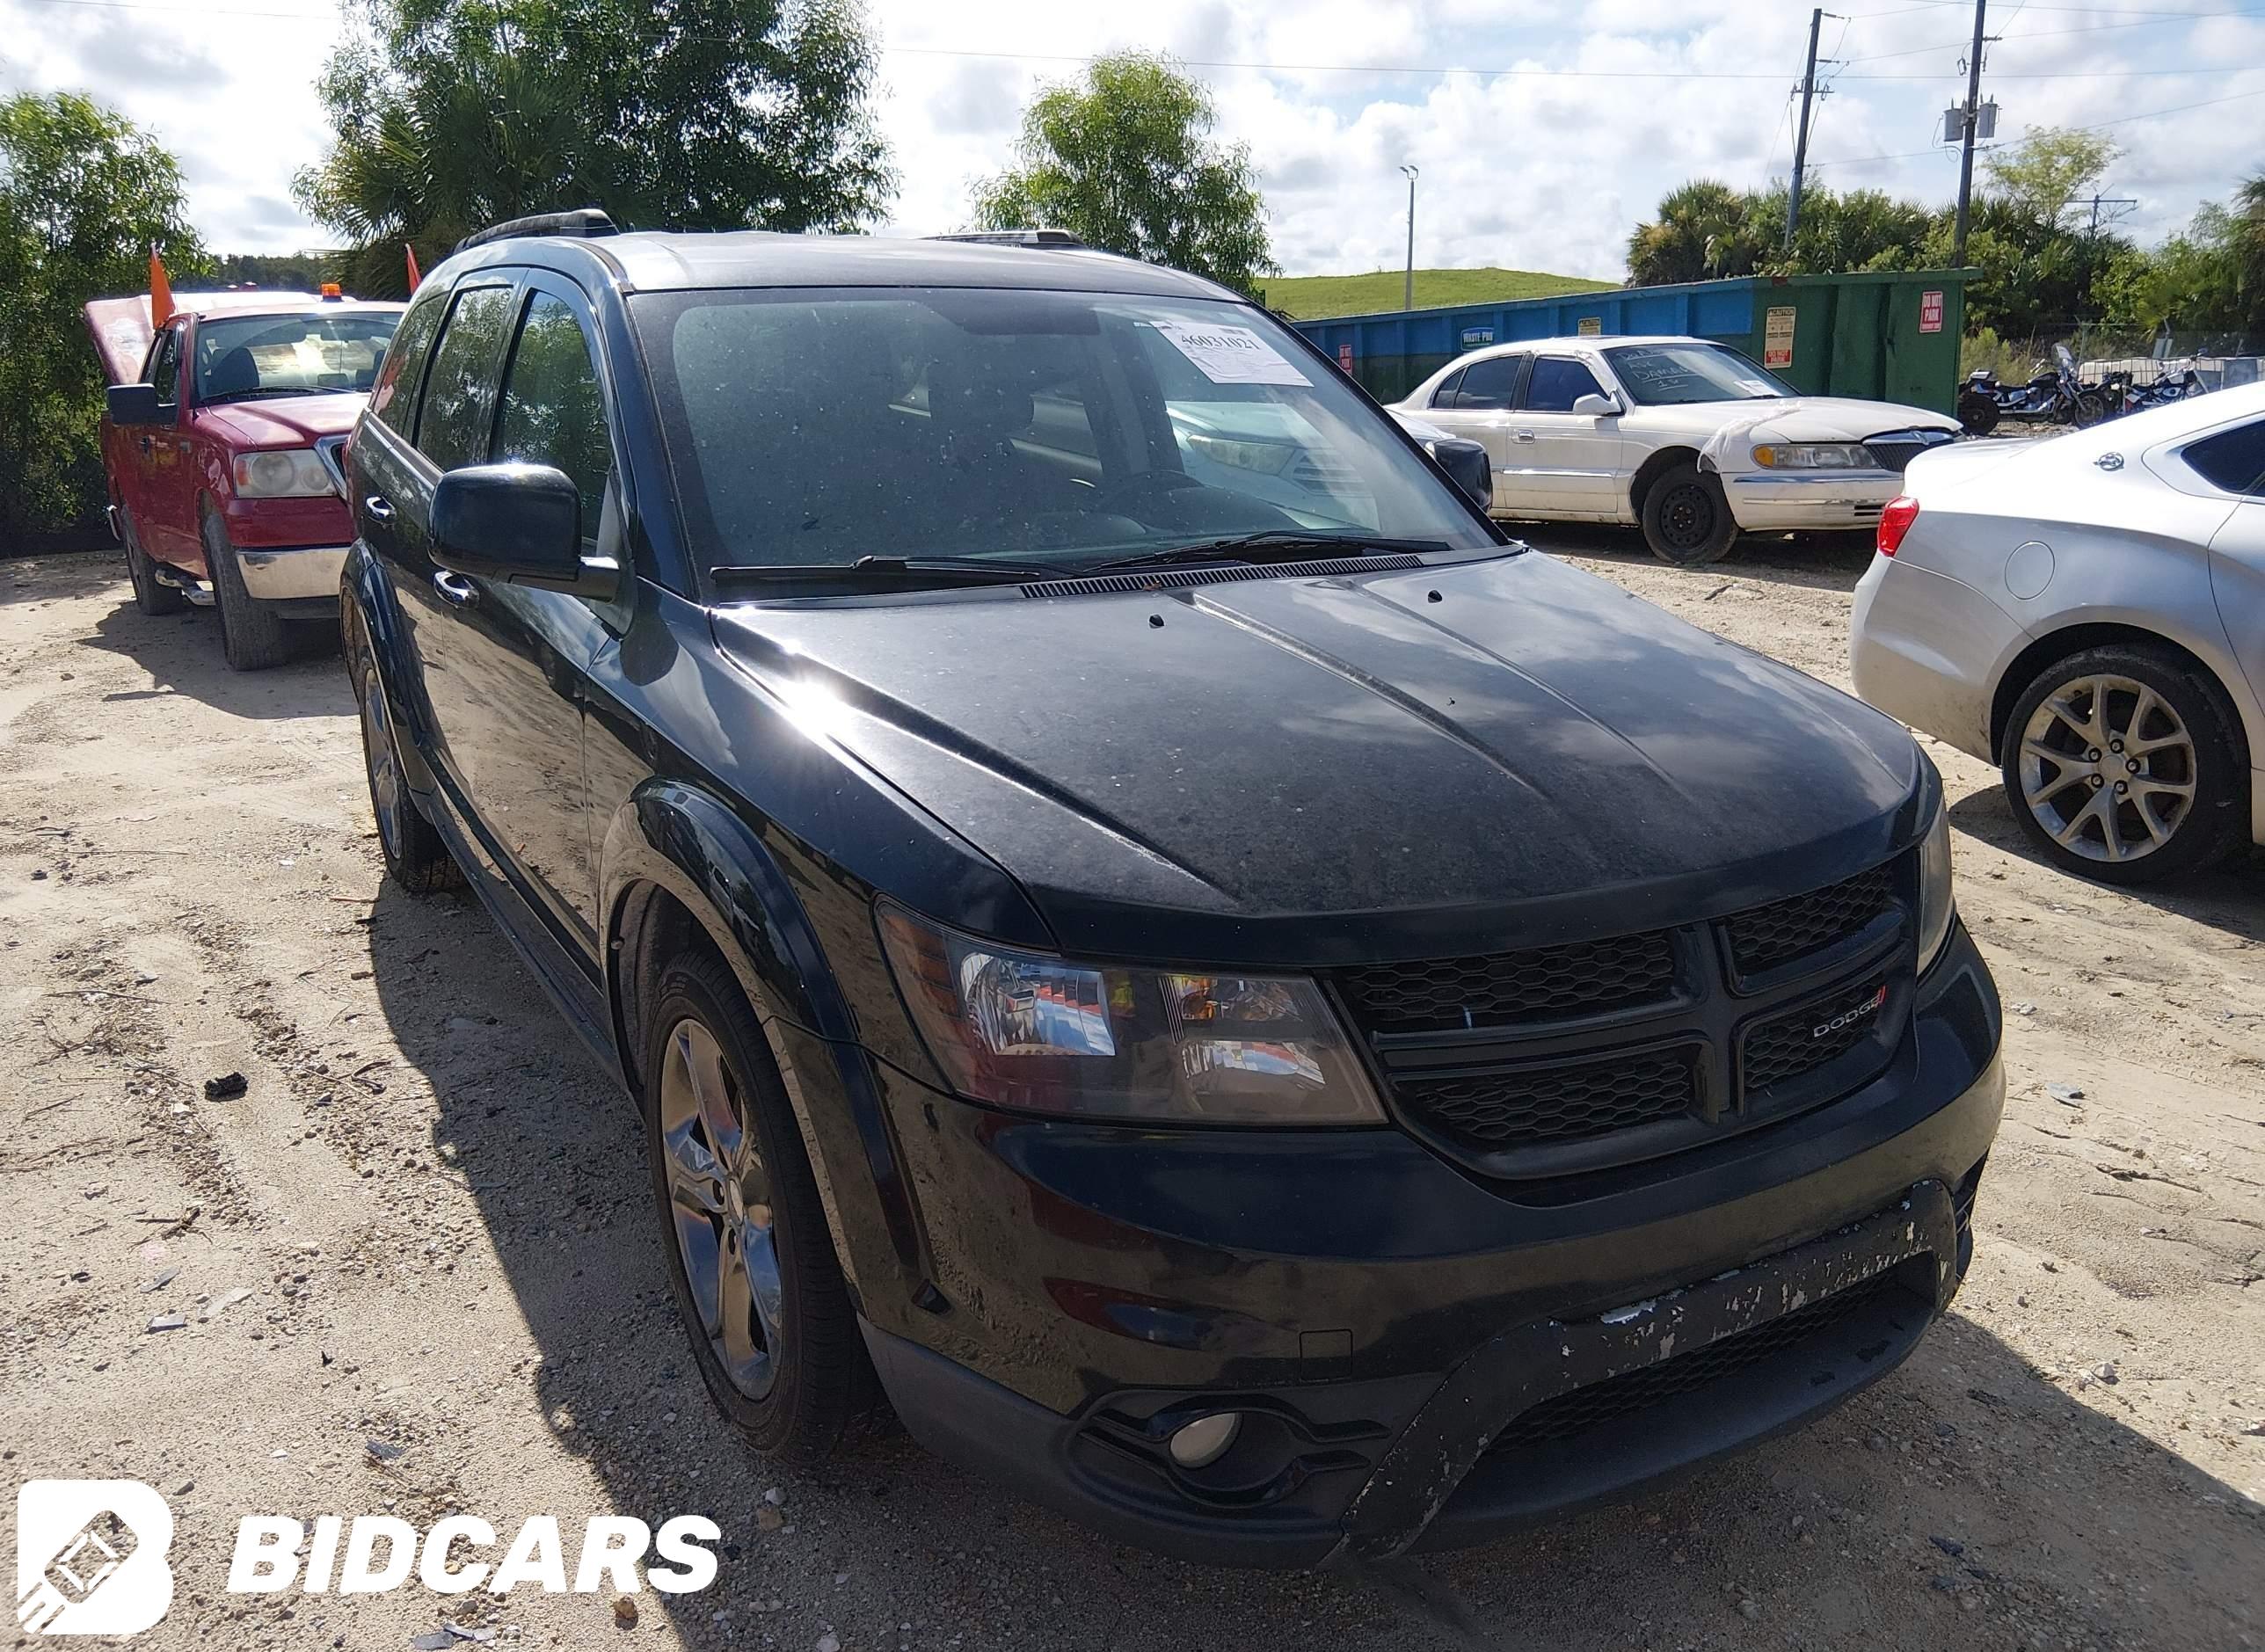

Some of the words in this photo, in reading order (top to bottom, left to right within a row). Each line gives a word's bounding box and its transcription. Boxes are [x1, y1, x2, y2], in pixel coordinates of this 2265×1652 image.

[1923, 295, 1931, 308] DO
[1932, 295, 1941, 308] NOT
[1925, 309, 1940, 322] PARK
[1181, 334, 1260, 350] 46031021
[1463, 332, 1481, 343] WASTE
[1813, 995, 1880, 1037] DODGE
